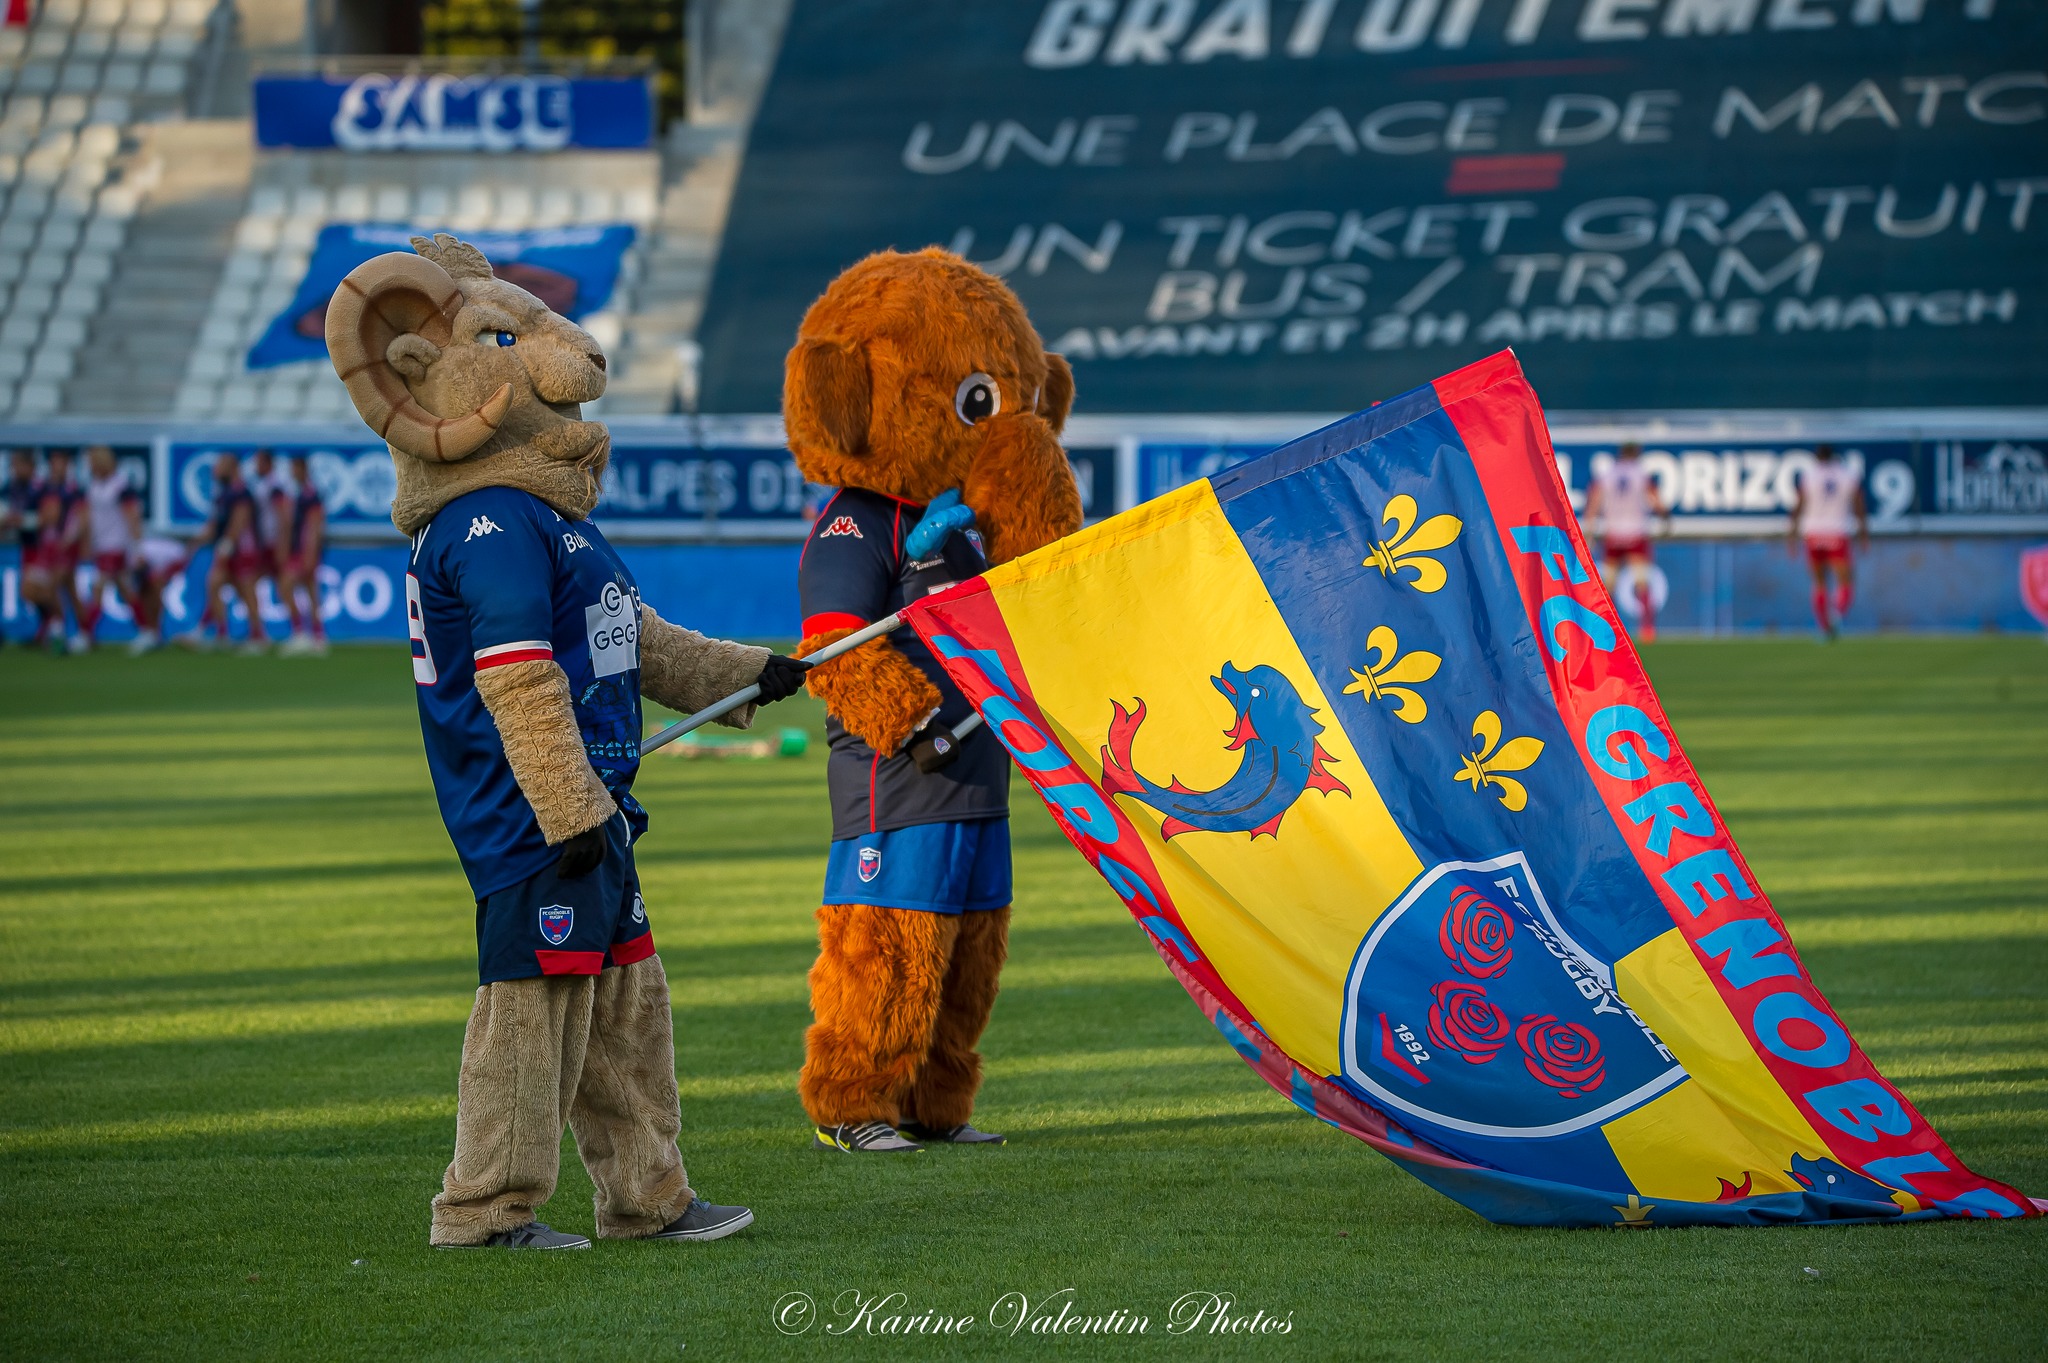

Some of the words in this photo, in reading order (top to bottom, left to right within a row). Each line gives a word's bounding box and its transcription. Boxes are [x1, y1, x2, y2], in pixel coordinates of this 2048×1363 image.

[902, 115, 1138, 174] UNE
[1163, 98, 1508, 163] PLACE
[1536, 90, 1681, 146] DE
[948, 219, 1124, 278] UN
[1157, 200, 1537, 270] TICKET
[1561, 176, 2048, 252] GRATUIT
[1048, 321, 1279, 361] AVANT
[1280, 316, 1361, 354] ET
[1690, 295, 1764, 337] LE
[1774, 286, 2020, 334] MATCH
[1146, 262, 1373, 324] BUS
[1494, 240, 1824, 304] TRAM
[1510, 524, 1617, 664] FC
[1393, 1023, 1431, 1065] 1892
